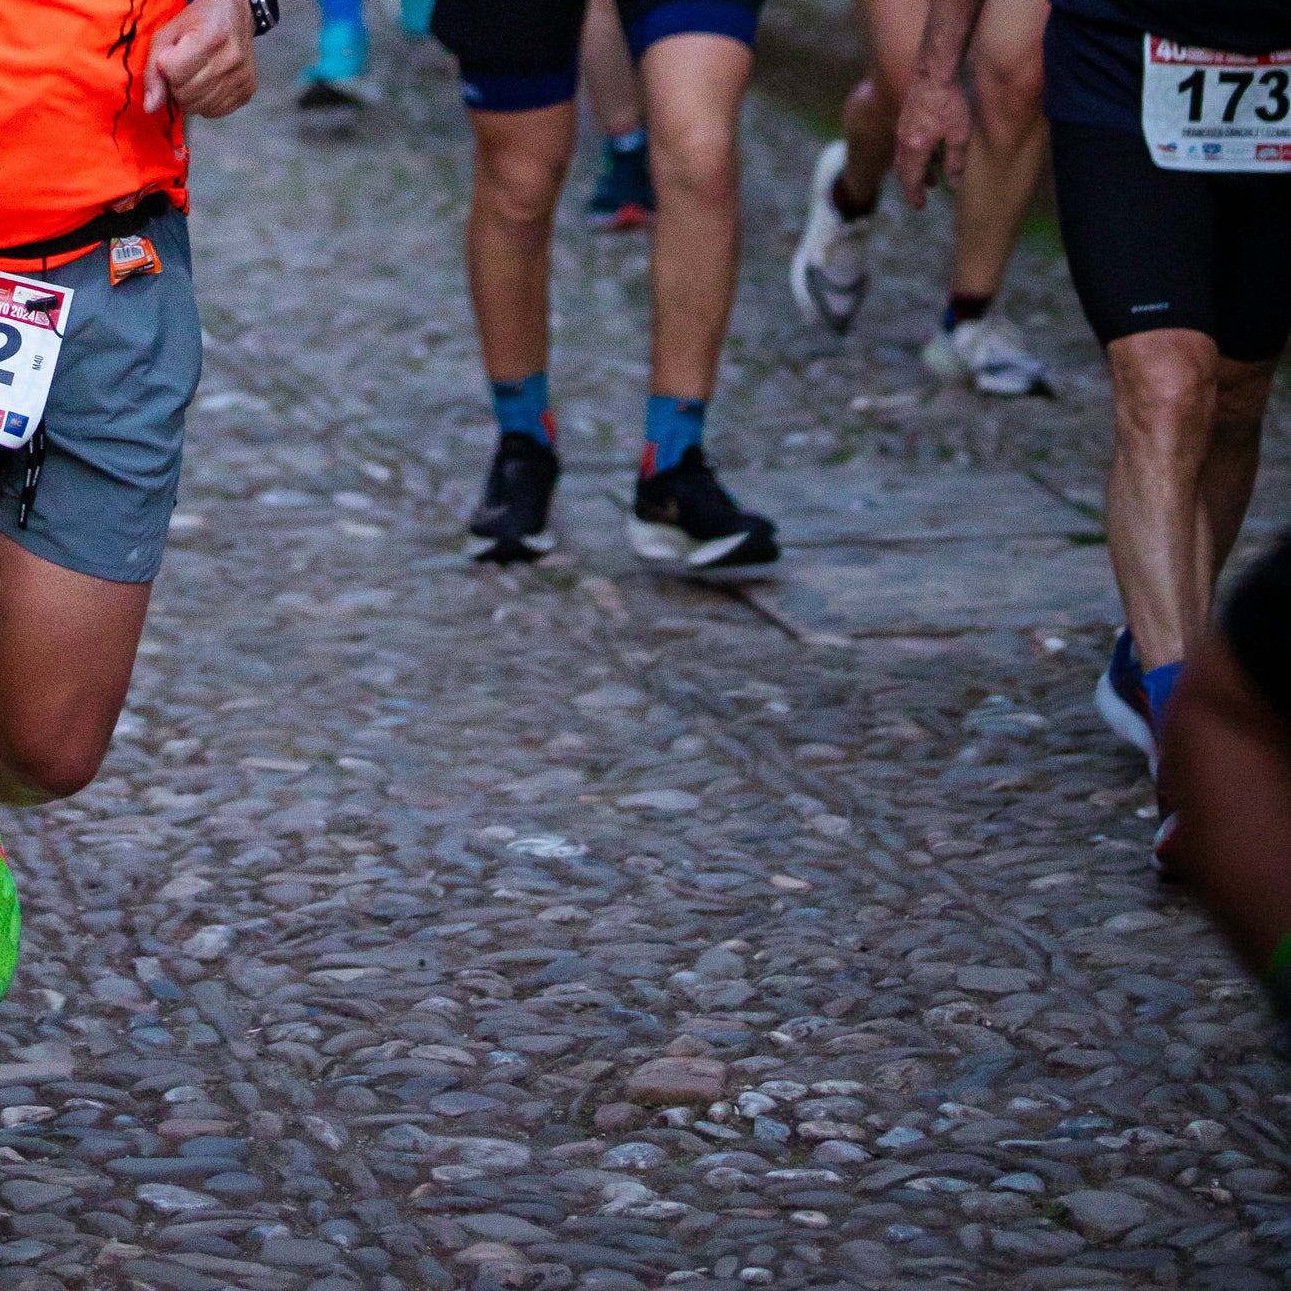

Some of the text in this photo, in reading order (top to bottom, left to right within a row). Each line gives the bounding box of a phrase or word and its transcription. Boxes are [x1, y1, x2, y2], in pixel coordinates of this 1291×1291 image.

[1177, 68, 1291, 122] 173
[10, 304, 36, 323] 2024
[31, 354, 44, 371] M40
